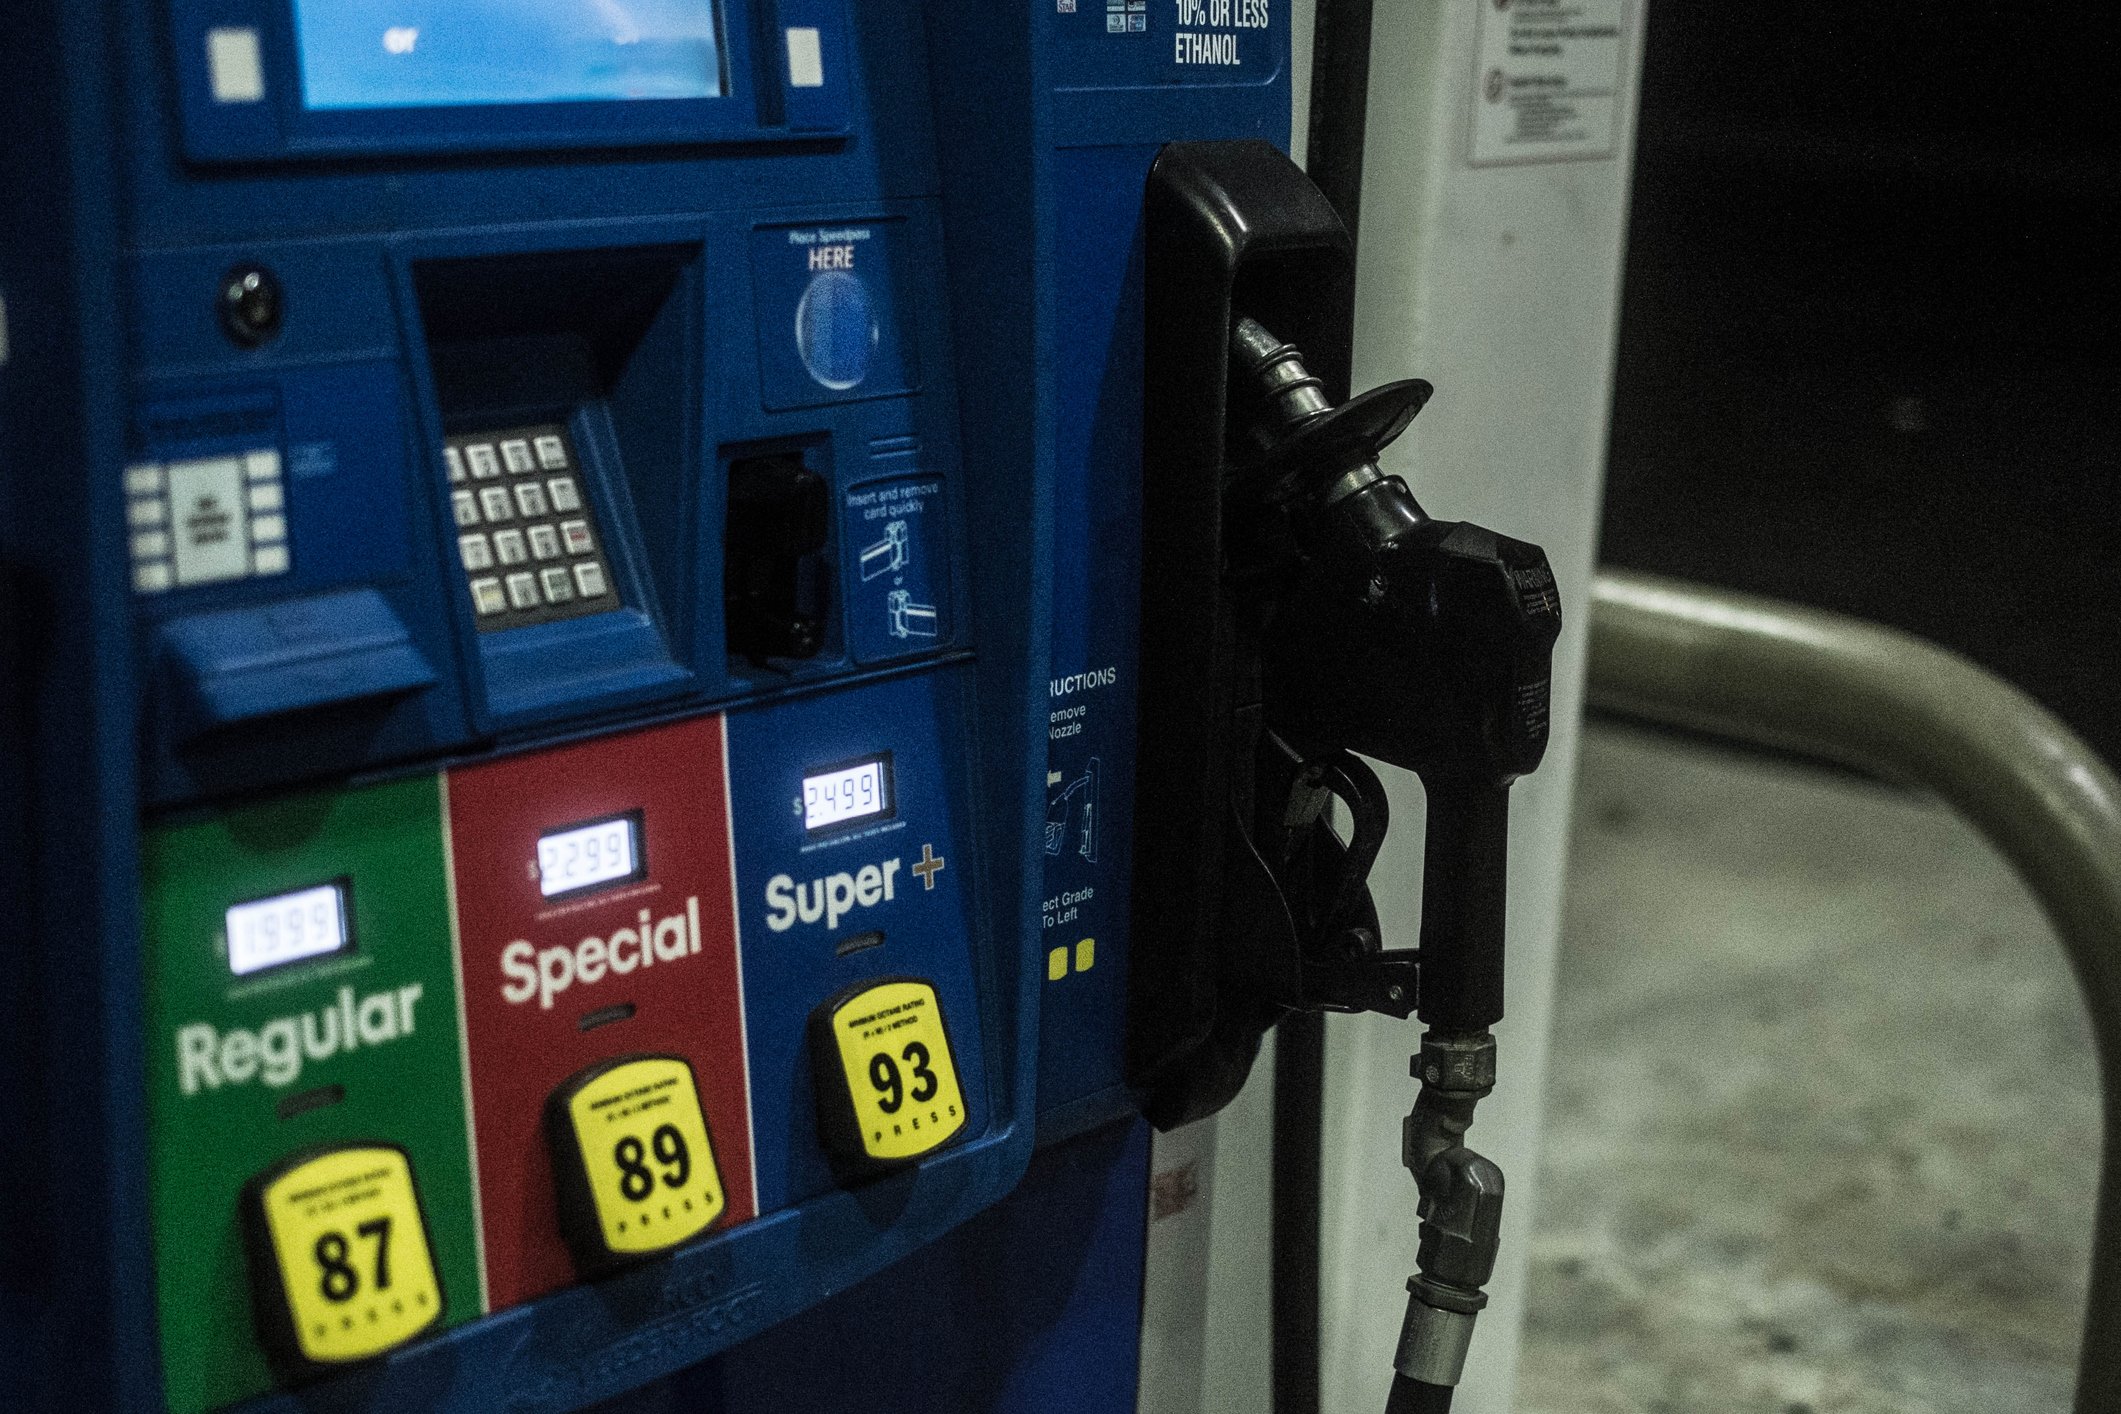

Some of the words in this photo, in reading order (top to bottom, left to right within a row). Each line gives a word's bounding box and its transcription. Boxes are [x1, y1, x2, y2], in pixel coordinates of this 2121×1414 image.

[1176, 0, 1206, 26] 10%
[1210, 0, 1230, 27] OR
[1234, 0, 1269, 29] LESS
[1175, 32, 1241, 65] ETHANOL
[808, 244, 854, 271] HERE
[879, 486, 899, 501] and
[900, 483, 938, 498] remove
[865, 503, 887, 520] card
[1049, 721, 1082, 740] Nozzle
[765, 857, 900, 932] Super
[1061, 886, 1094, 906] Grade
[1042, 915, 1055, 929] To
[1057, 906, 1078, 925] Left
[501, 895, 702, 1010] Special
[176, 982, 424, 1097] Regular
[869, 1041, 938, 1114] 93
[614, 1123, 691, 1203] 89
[314, 1216, 392, 1303] 87
